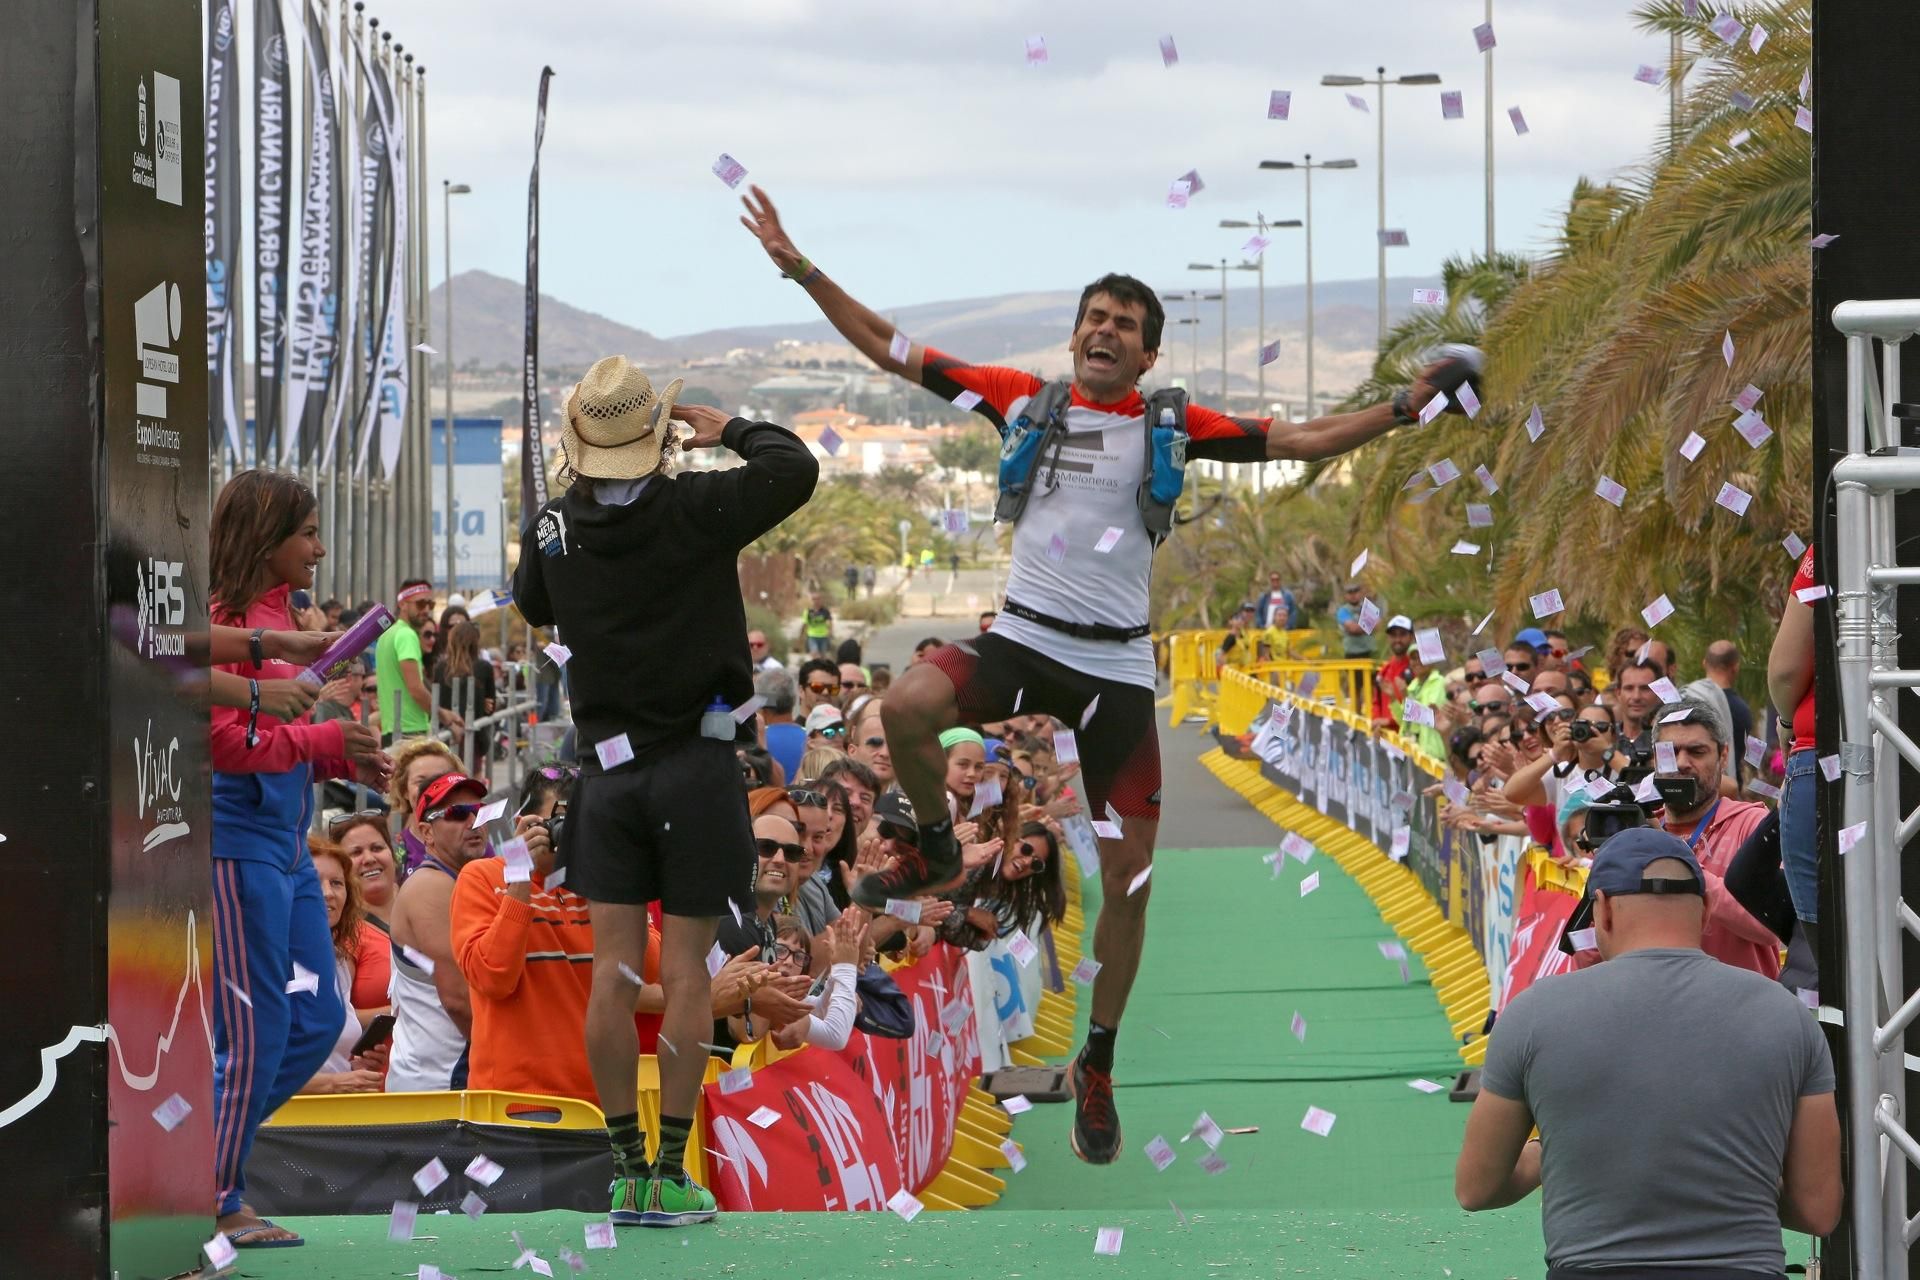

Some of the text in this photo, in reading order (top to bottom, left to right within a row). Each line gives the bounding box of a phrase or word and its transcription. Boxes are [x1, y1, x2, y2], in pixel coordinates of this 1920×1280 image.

[137, 419, 180, 451] ExpoMeloneras
[537, 520, 556, 541] META
[155, 634, 185, 656] SONOCOM
